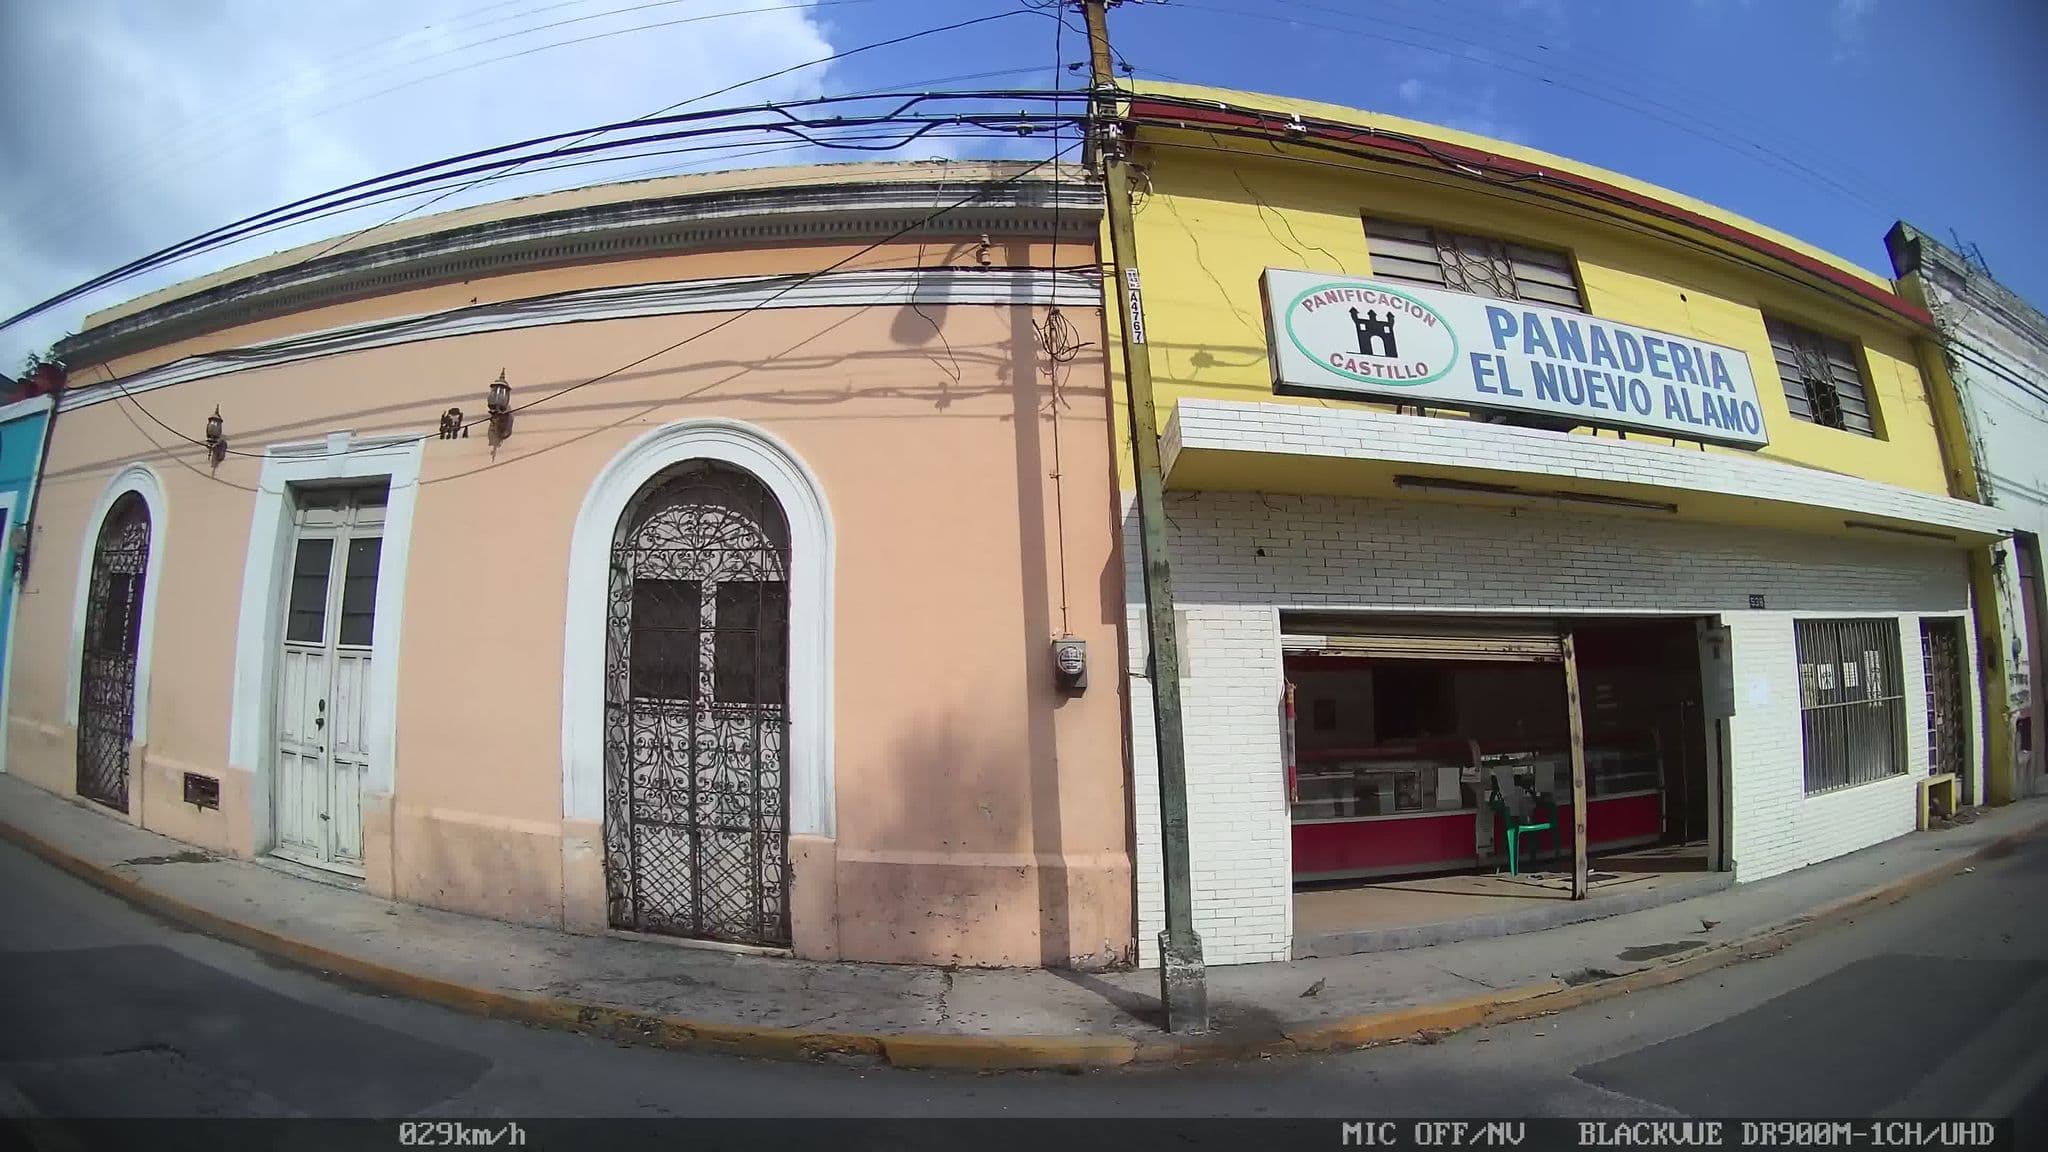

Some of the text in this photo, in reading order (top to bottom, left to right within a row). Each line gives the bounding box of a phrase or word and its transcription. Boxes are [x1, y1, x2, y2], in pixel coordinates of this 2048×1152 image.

[1130, 291, 1142, 342] A4767
[1302, 289, 1437, 328] PANIFICACION
[1329, 353, 1429, 379] CASTILLO
[1485, 305, 1736, 393] PANADERIA
[1470, 352, 1760, 435] EL NUEVO ALAMO
